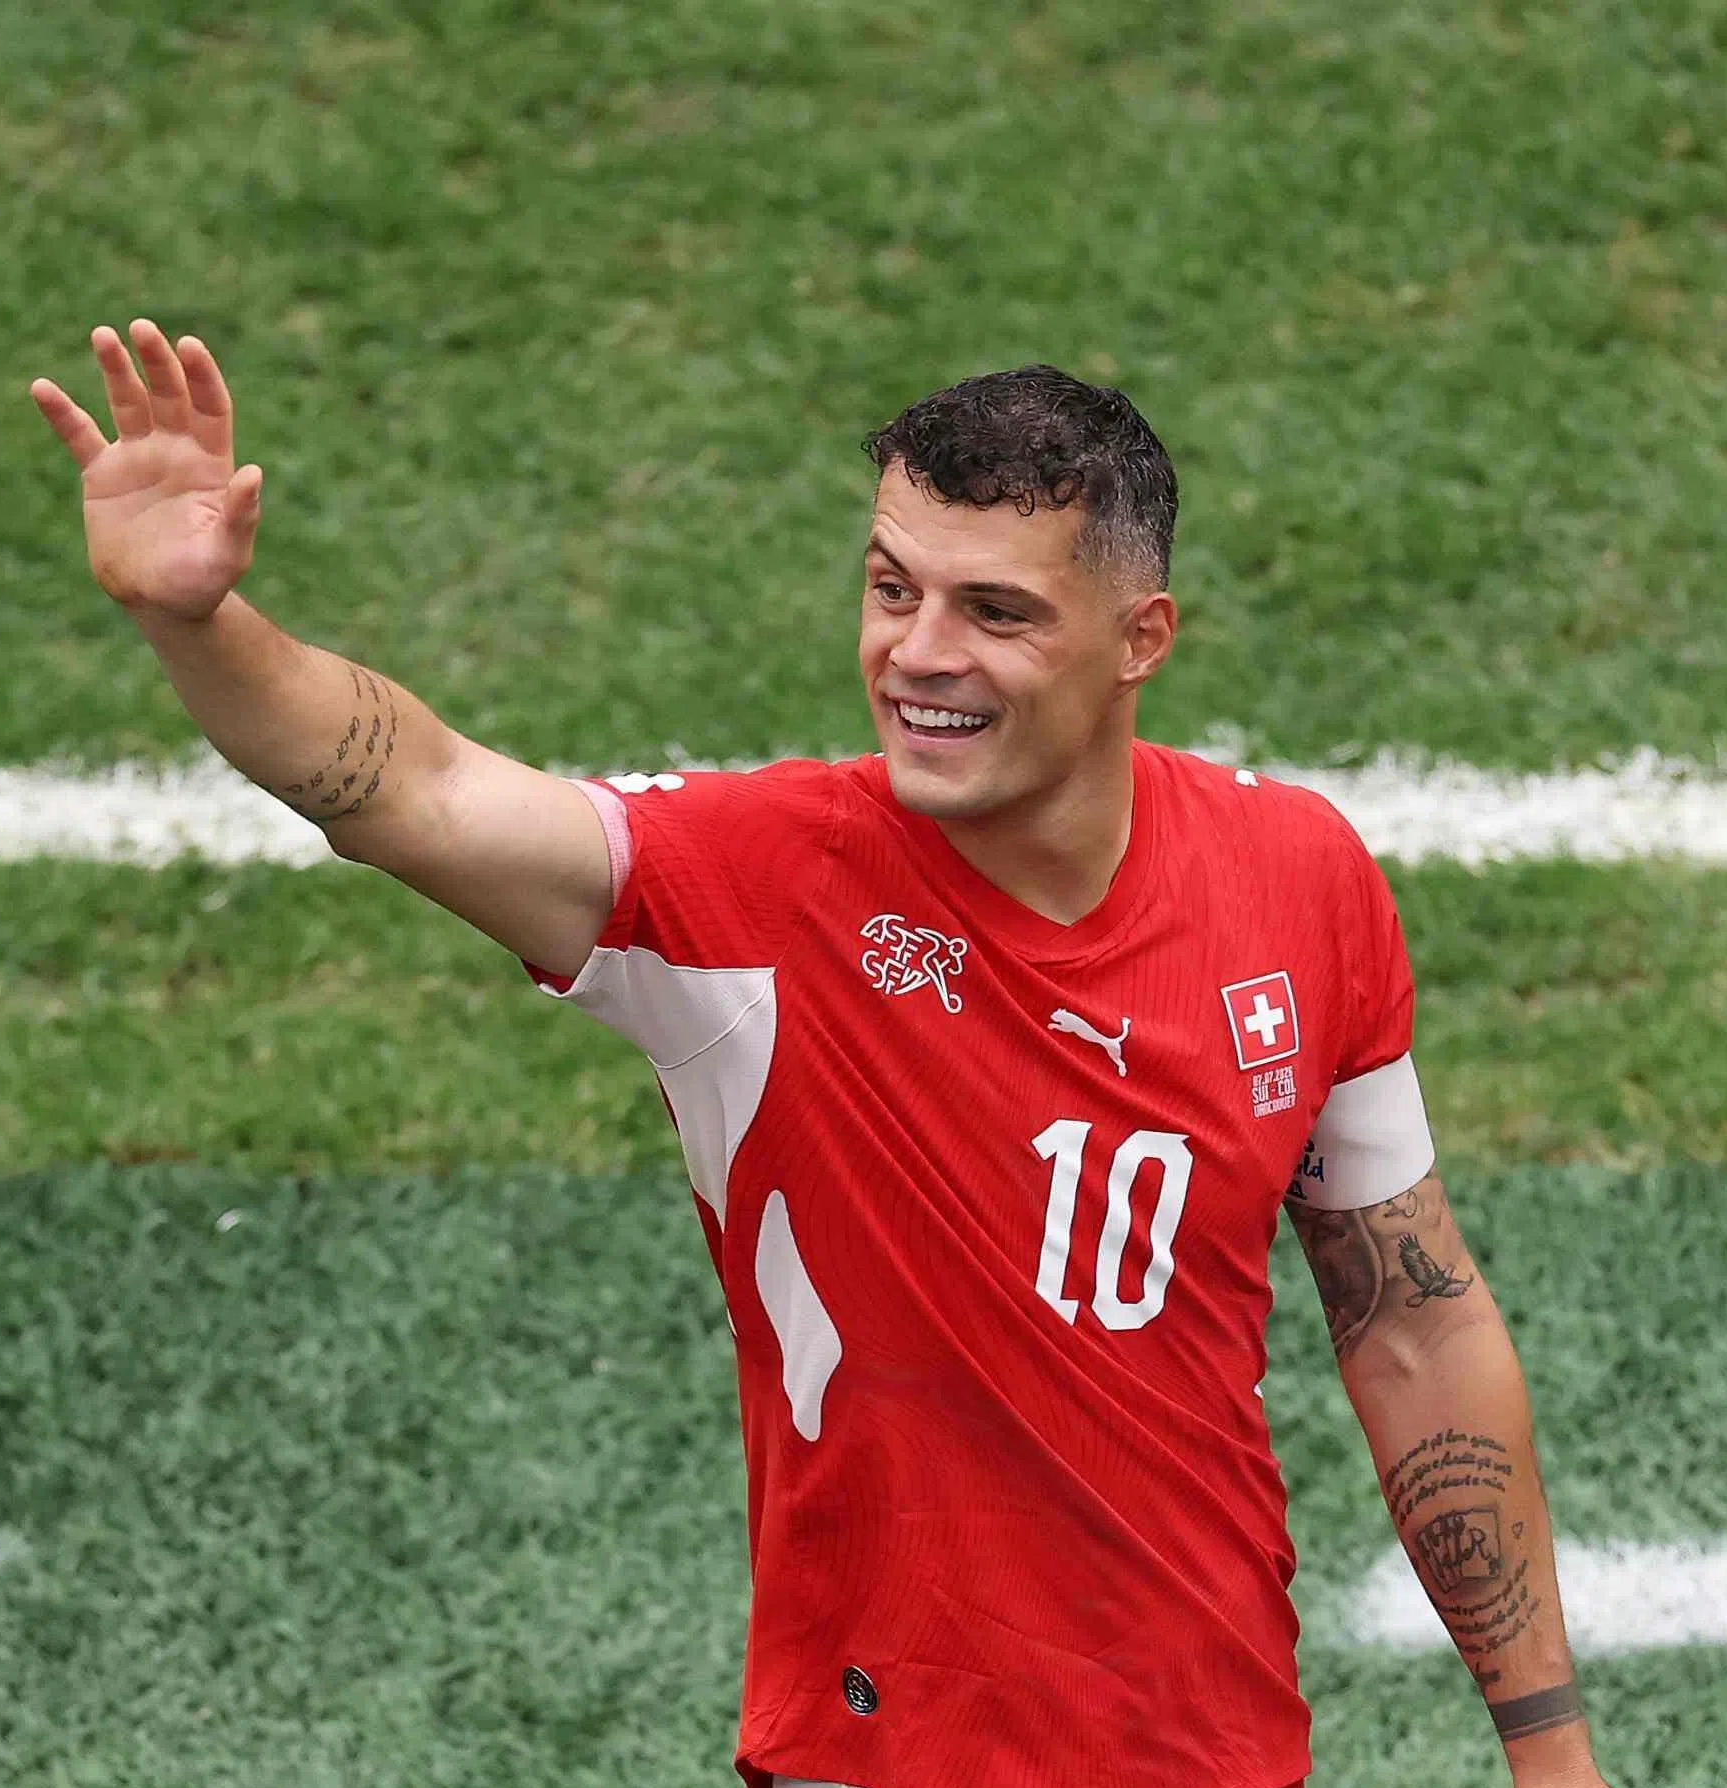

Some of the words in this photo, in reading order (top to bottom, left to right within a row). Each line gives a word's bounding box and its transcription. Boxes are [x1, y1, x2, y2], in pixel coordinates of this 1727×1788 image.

[1251, 1081, 1269, 1104] SUI
[1277, 1077, 1297, 1097] COL
[1030, 1118, 1195, 1331] 10
